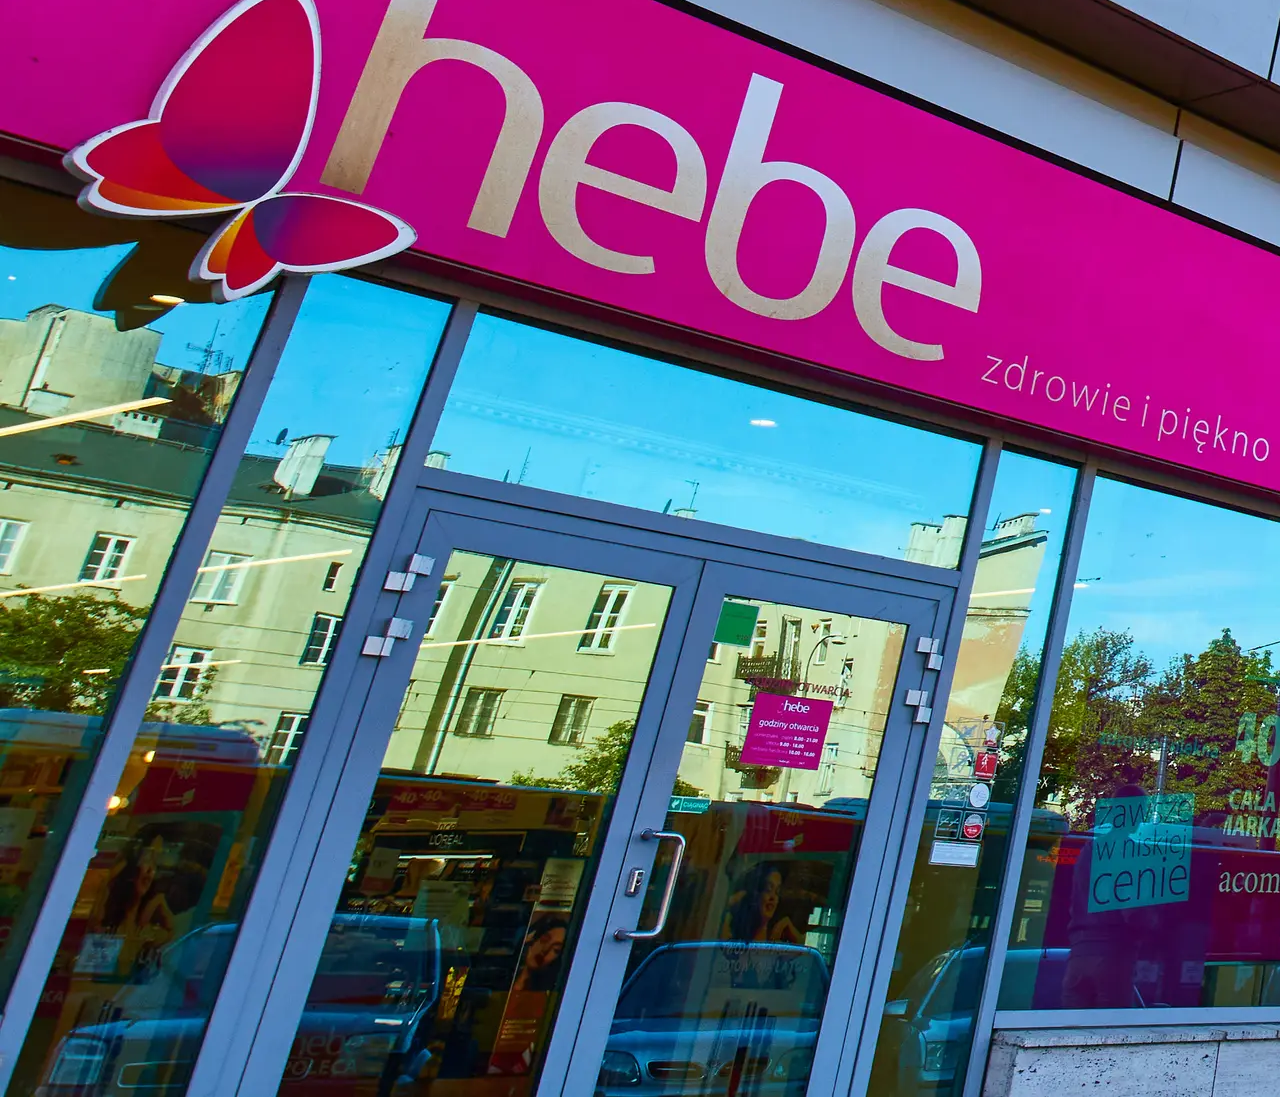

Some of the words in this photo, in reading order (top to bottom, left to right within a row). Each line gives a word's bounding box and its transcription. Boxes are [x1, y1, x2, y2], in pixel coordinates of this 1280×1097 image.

[980, 352, 1131, 423] zdrowie
[1141, 396, 1149, 427] i
[1158, 407, 1271, 463] piękno
[783, 700, 810, 714] hebe
[758, 718, 788, 730] godziny
[789, 722, 820, 733] otwarcia
[1098, 798, 1192, 830] zawsze
[1096, 840, 1116, 861] w
[1122, 828, 1188, 861] niskiej
[1092, 857, 1189, 906] cenie
